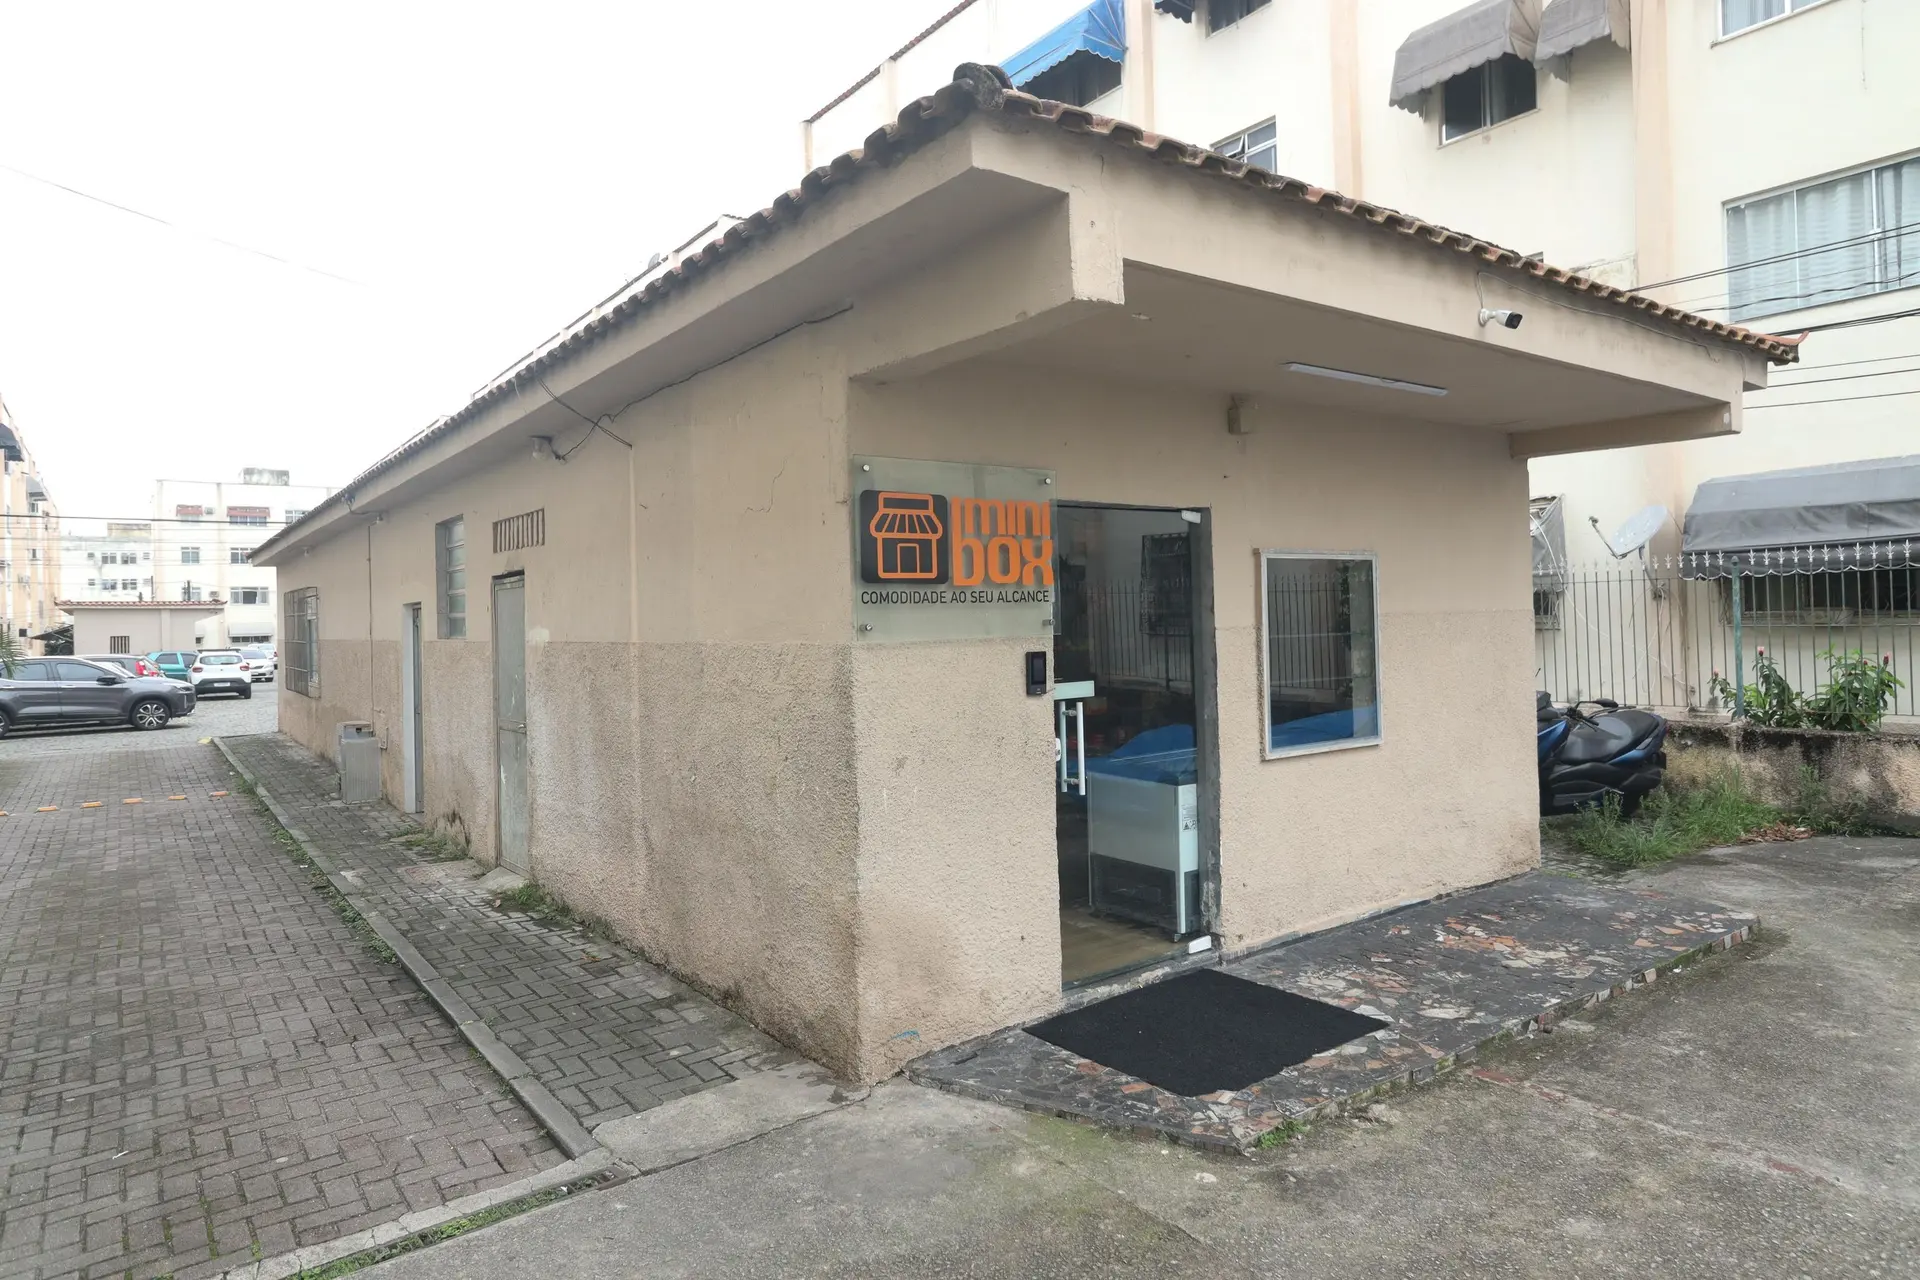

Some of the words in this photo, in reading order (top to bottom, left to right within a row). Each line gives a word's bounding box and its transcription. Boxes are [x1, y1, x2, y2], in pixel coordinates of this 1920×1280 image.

[951, 496, 1054, 586] box
[861, 590, 947, 605] COMODIDADE
[950, 590, 968, 604] AO
[970, 590, 994, 604] SEU
[997, 590, 1050, 604] ALCANCE
